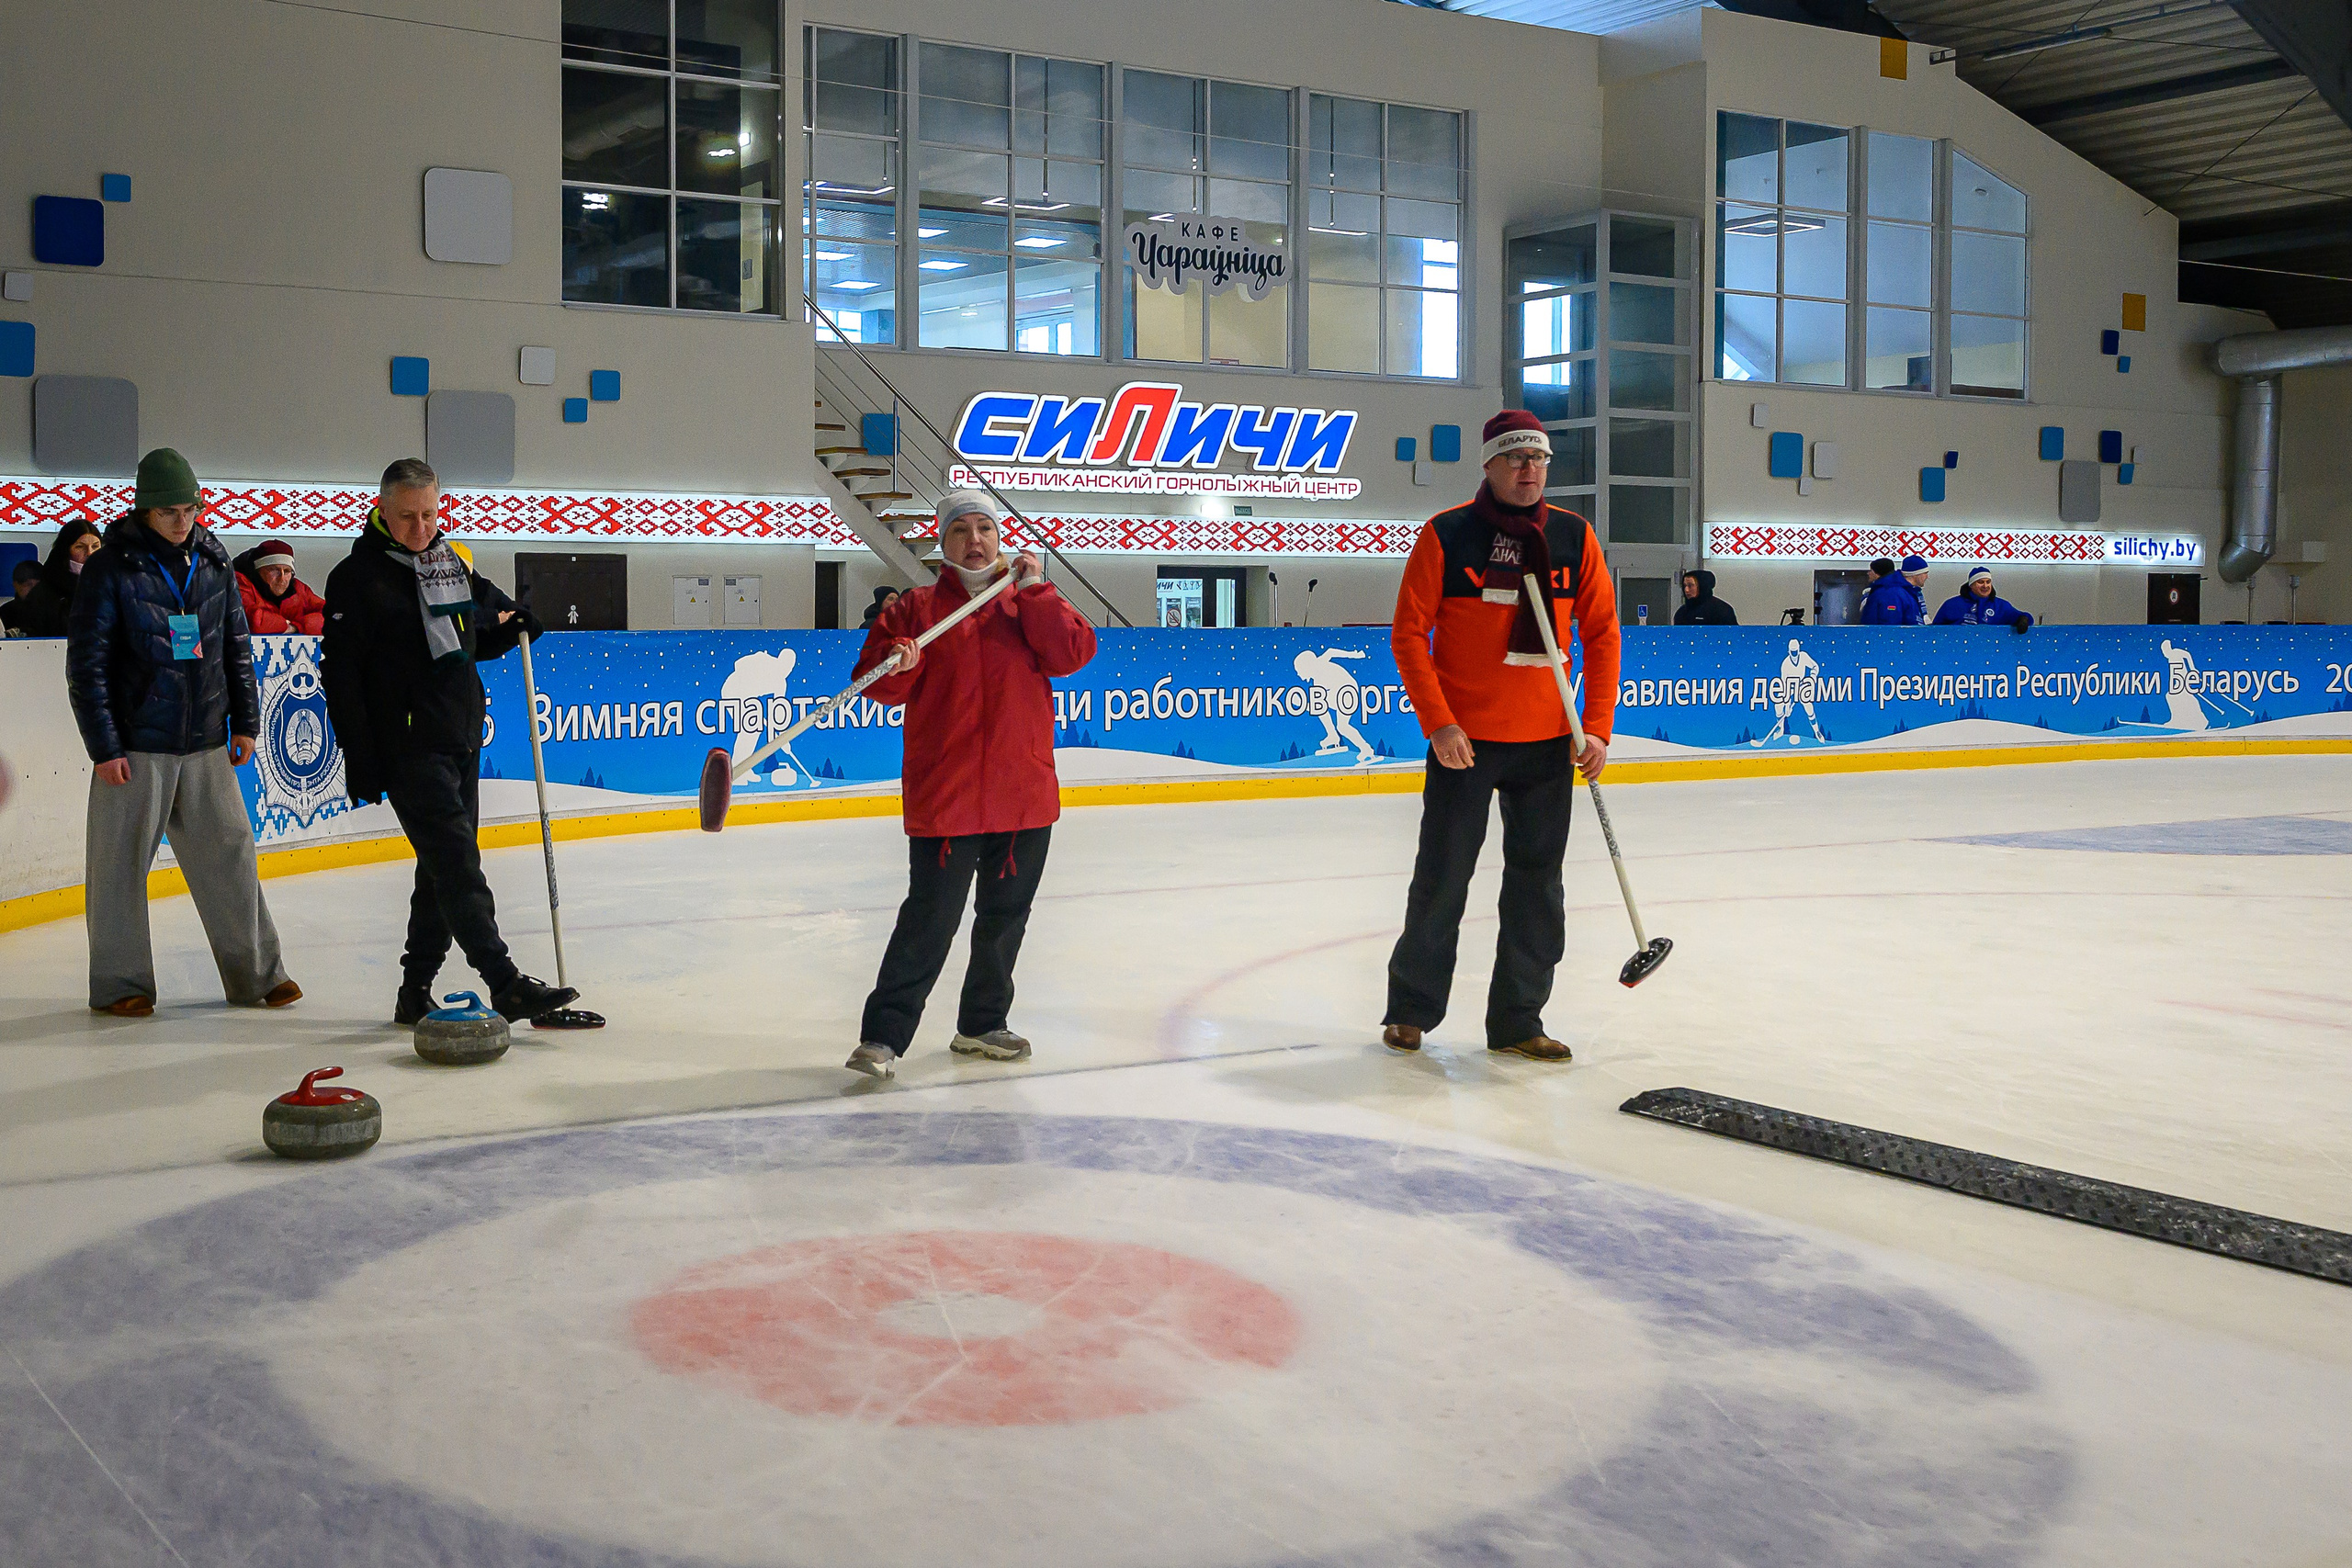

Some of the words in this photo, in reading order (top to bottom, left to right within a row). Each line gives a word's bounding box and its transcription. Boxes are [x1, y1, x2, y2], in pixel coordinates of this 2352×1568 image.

[1182, 221, 1238, 242] КАФЕ
[1132, 231, 1286, 290] Чараўніца
[954, 469, 1152, 490] РЕСПУБЛИКАНСКИЙ
[1157, 477, 1300, 493] ГОРНОЛЫЖНЫЙ
[1305, 482, 1358, 496] ЦЕНТР
[2114, 537, 2197, 560] silichy.by
[529, 693, 684, 743] Зимняя
[1103, 675, 1329, 731] работников
[1567, 671, 1744, 708] Уавления
[1750, 674, 1853, 710] делами
[1860, 668, 2009, 710] Президента
[2016, 662, 2162, 705] Республики
[2168, 662, 2300, 702] Беларусь
